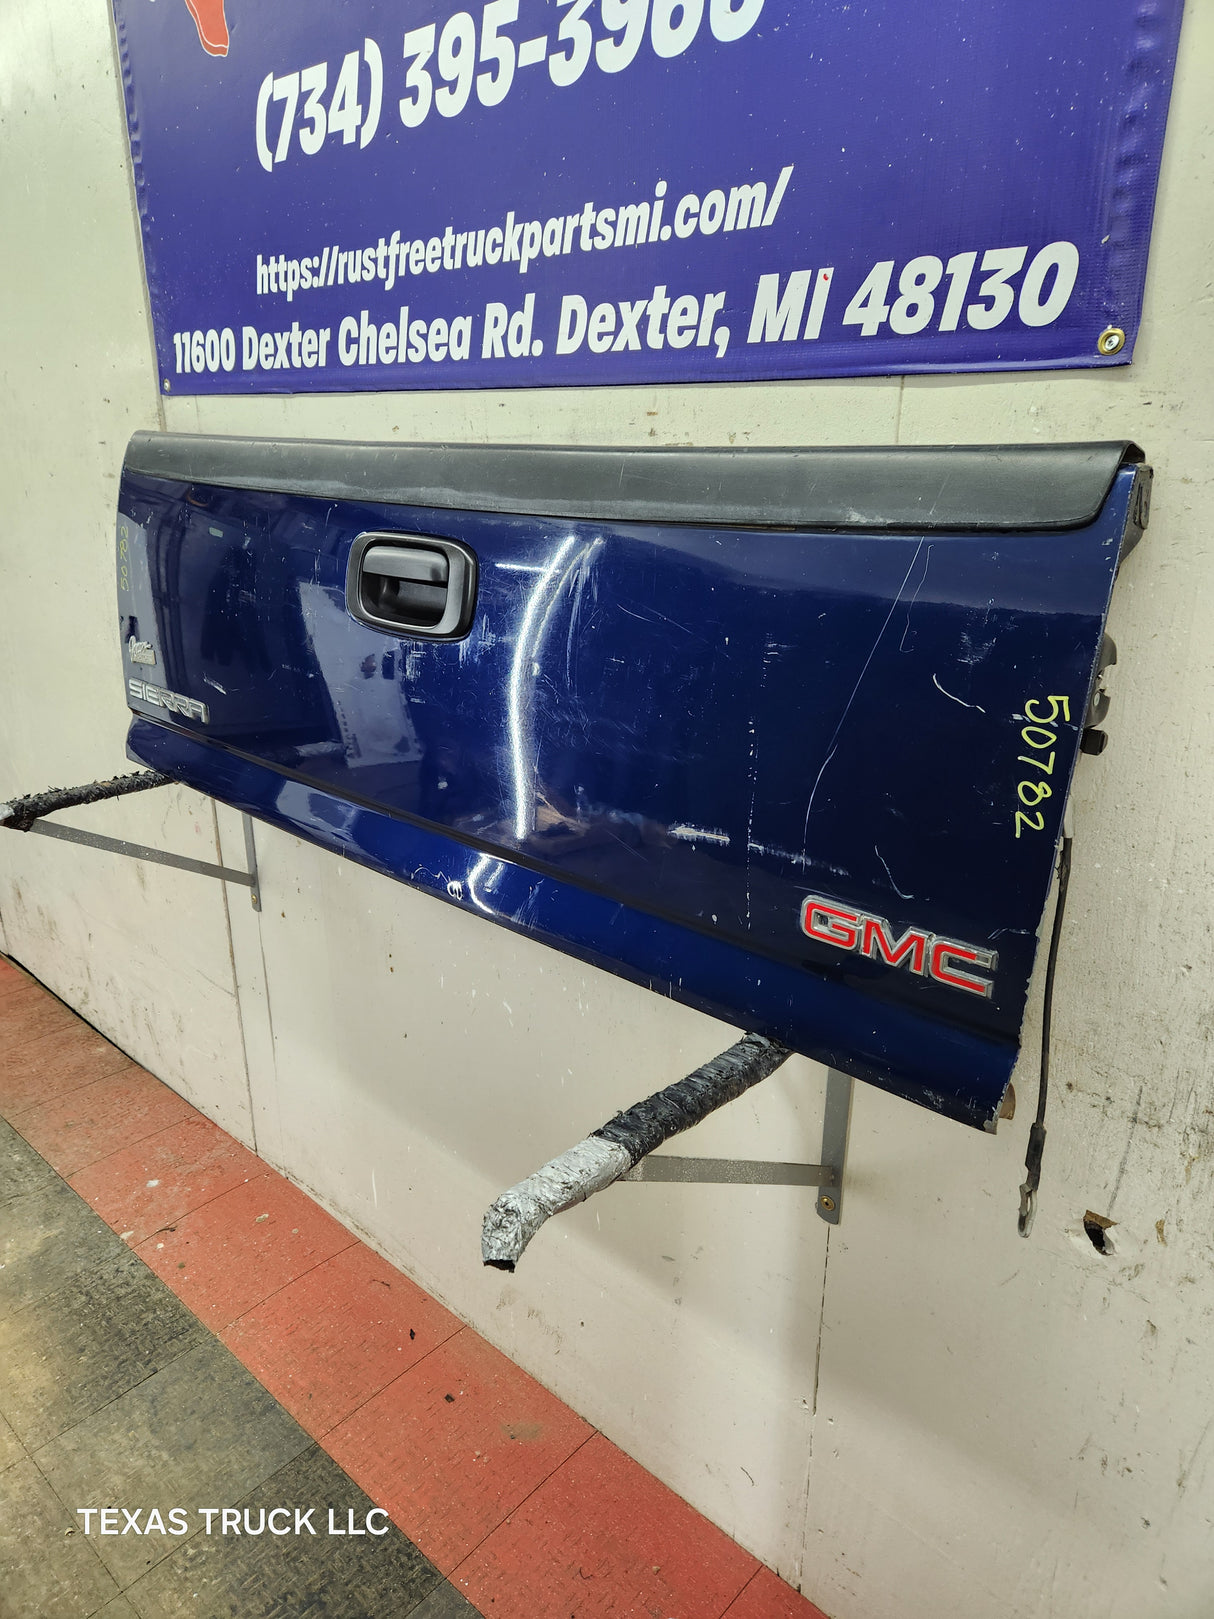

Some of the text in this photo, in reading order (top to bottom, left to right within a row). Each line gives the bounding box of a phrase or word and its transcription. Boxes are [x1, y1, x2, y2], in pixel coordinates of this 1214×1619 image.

[256, 37, 384, 172] (734)
[256, 165, 795, 302] https://rustfreetruckpartsmi.com/
[173, 240, 1080, 374] 11600 Dexter Chelsea Rd. Dexter, MI 48130
[128, 677, 210, 725] SIERRA
[1014, 694, 1072, 839] 50782
[800, 893, 999, 999] GMC
